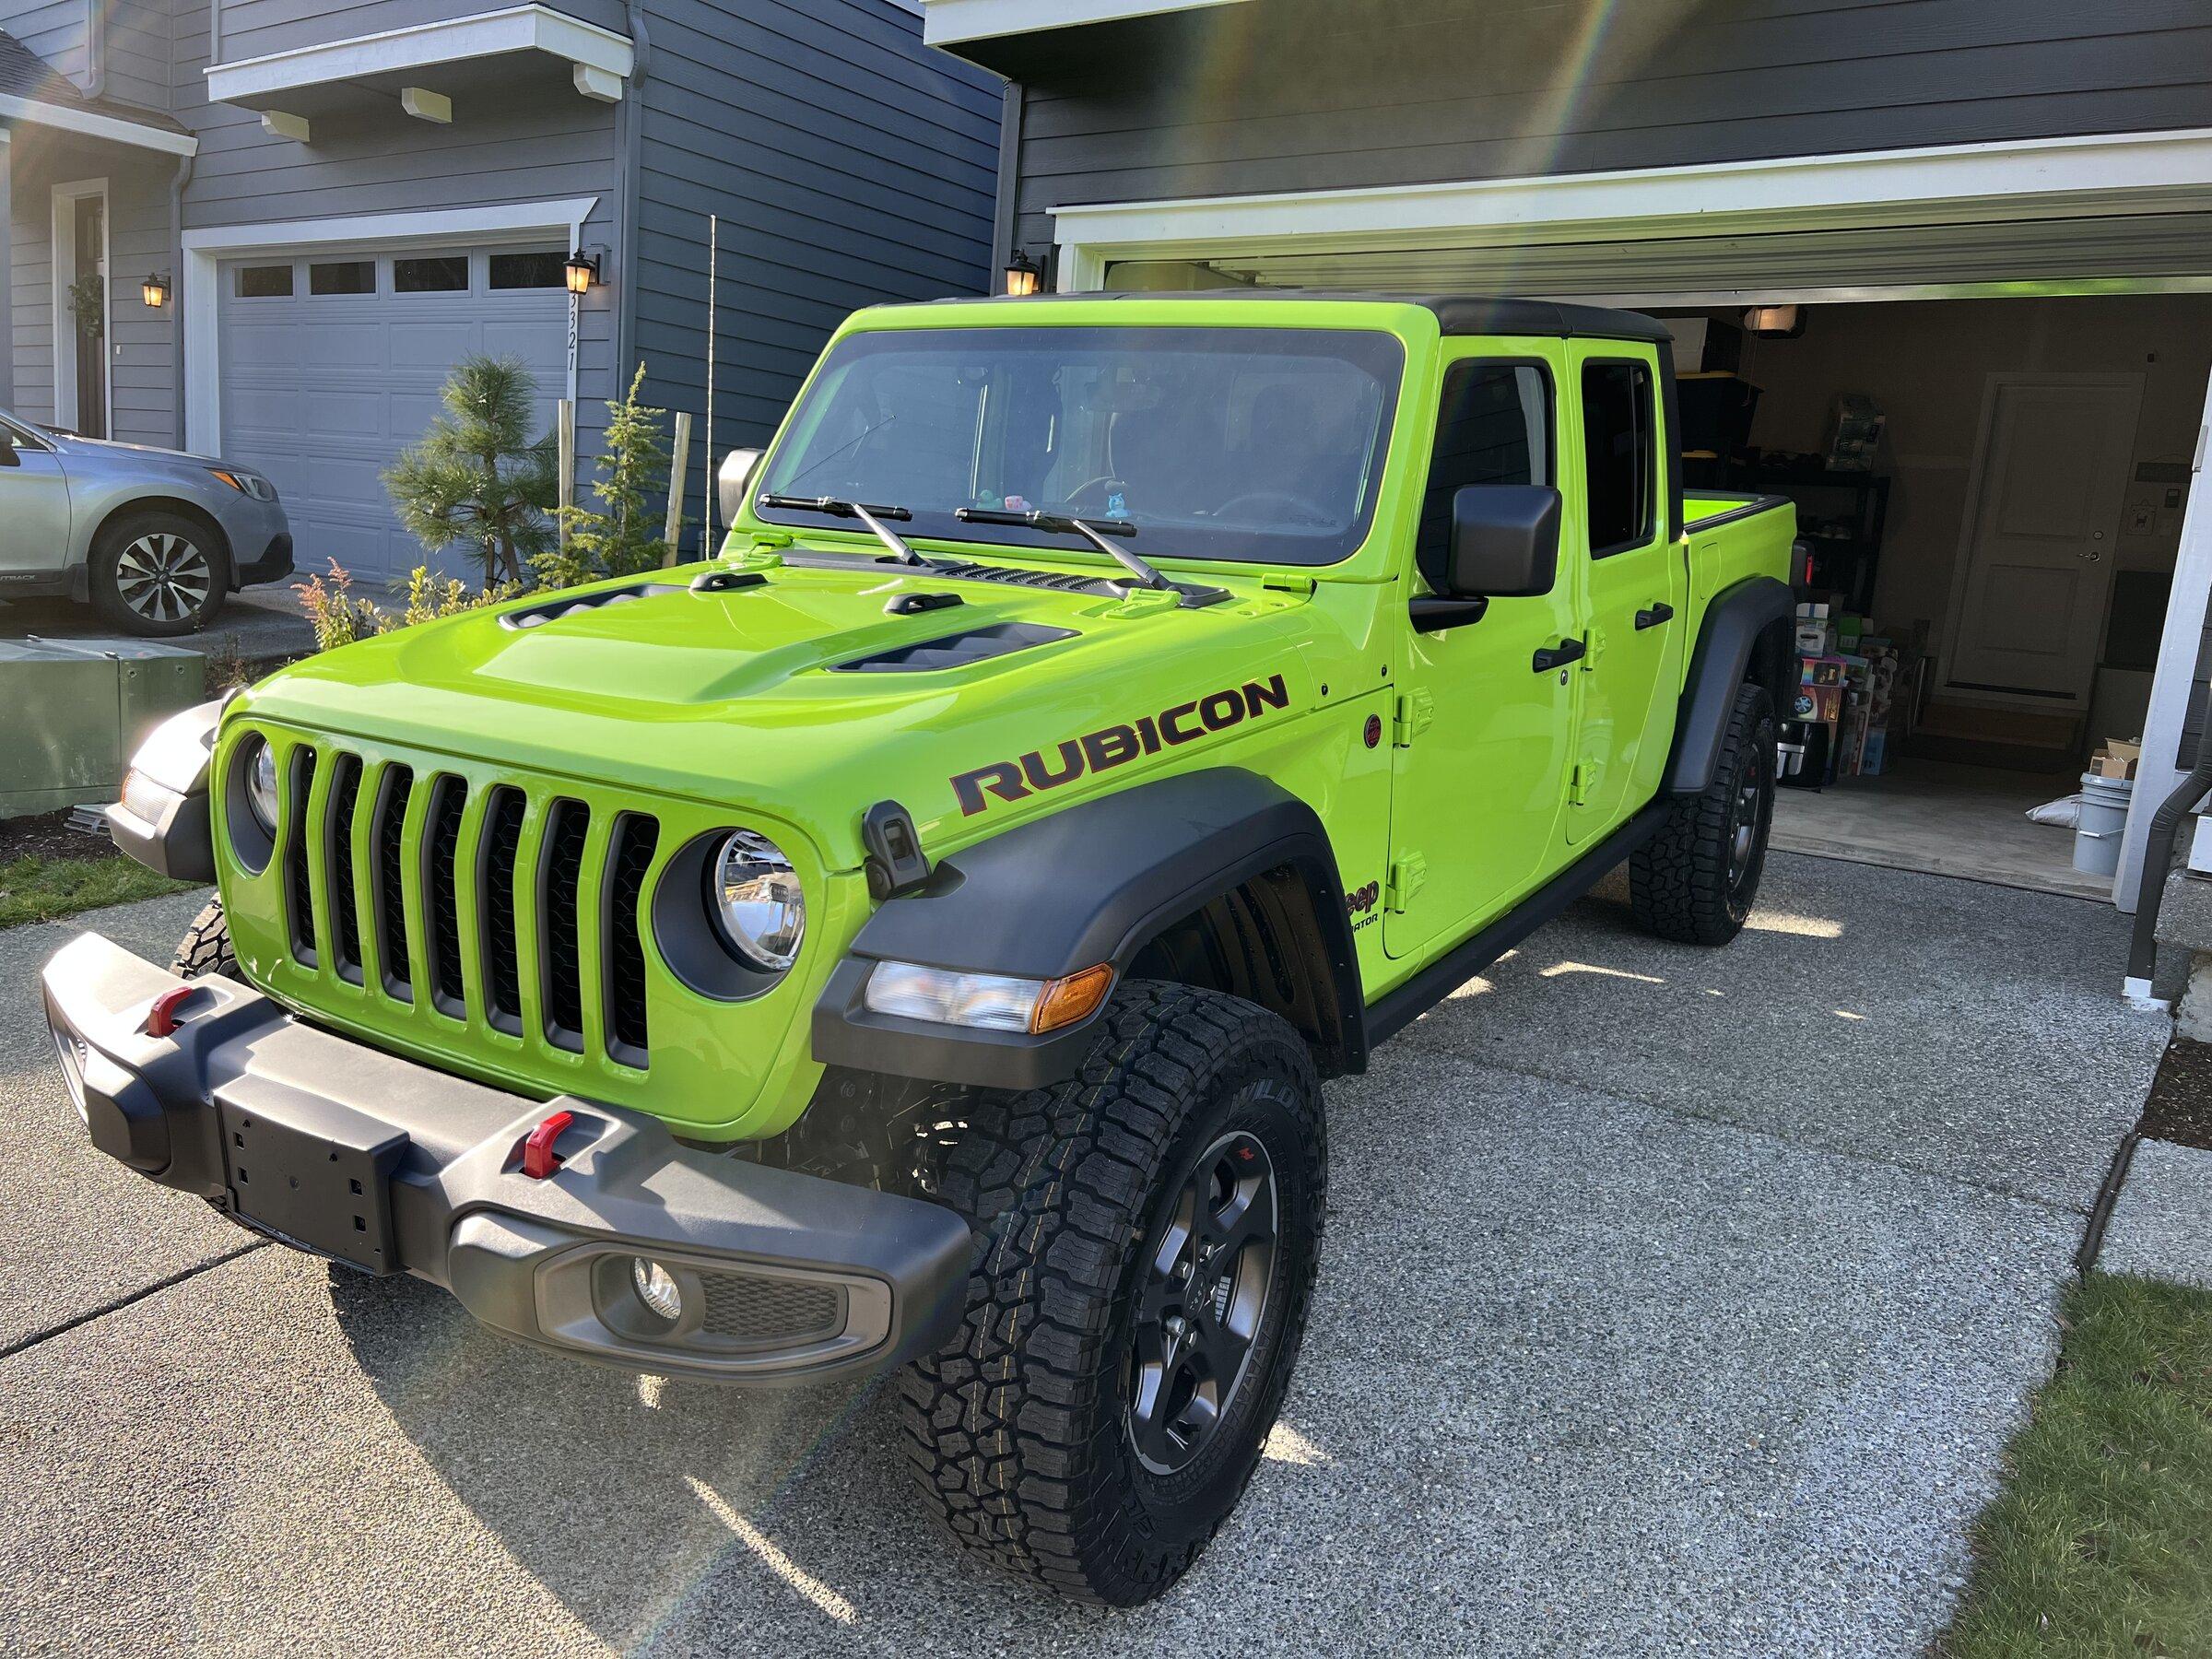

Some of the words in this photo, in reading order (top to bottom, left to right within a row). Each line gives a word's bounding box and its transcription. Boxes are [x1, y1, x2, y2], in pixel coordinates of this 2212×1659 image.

[568, 293, 577, 371] 3321
[948, 673, 1289, 817] RUBICON
[1345, 880, 1379, 916] eep
